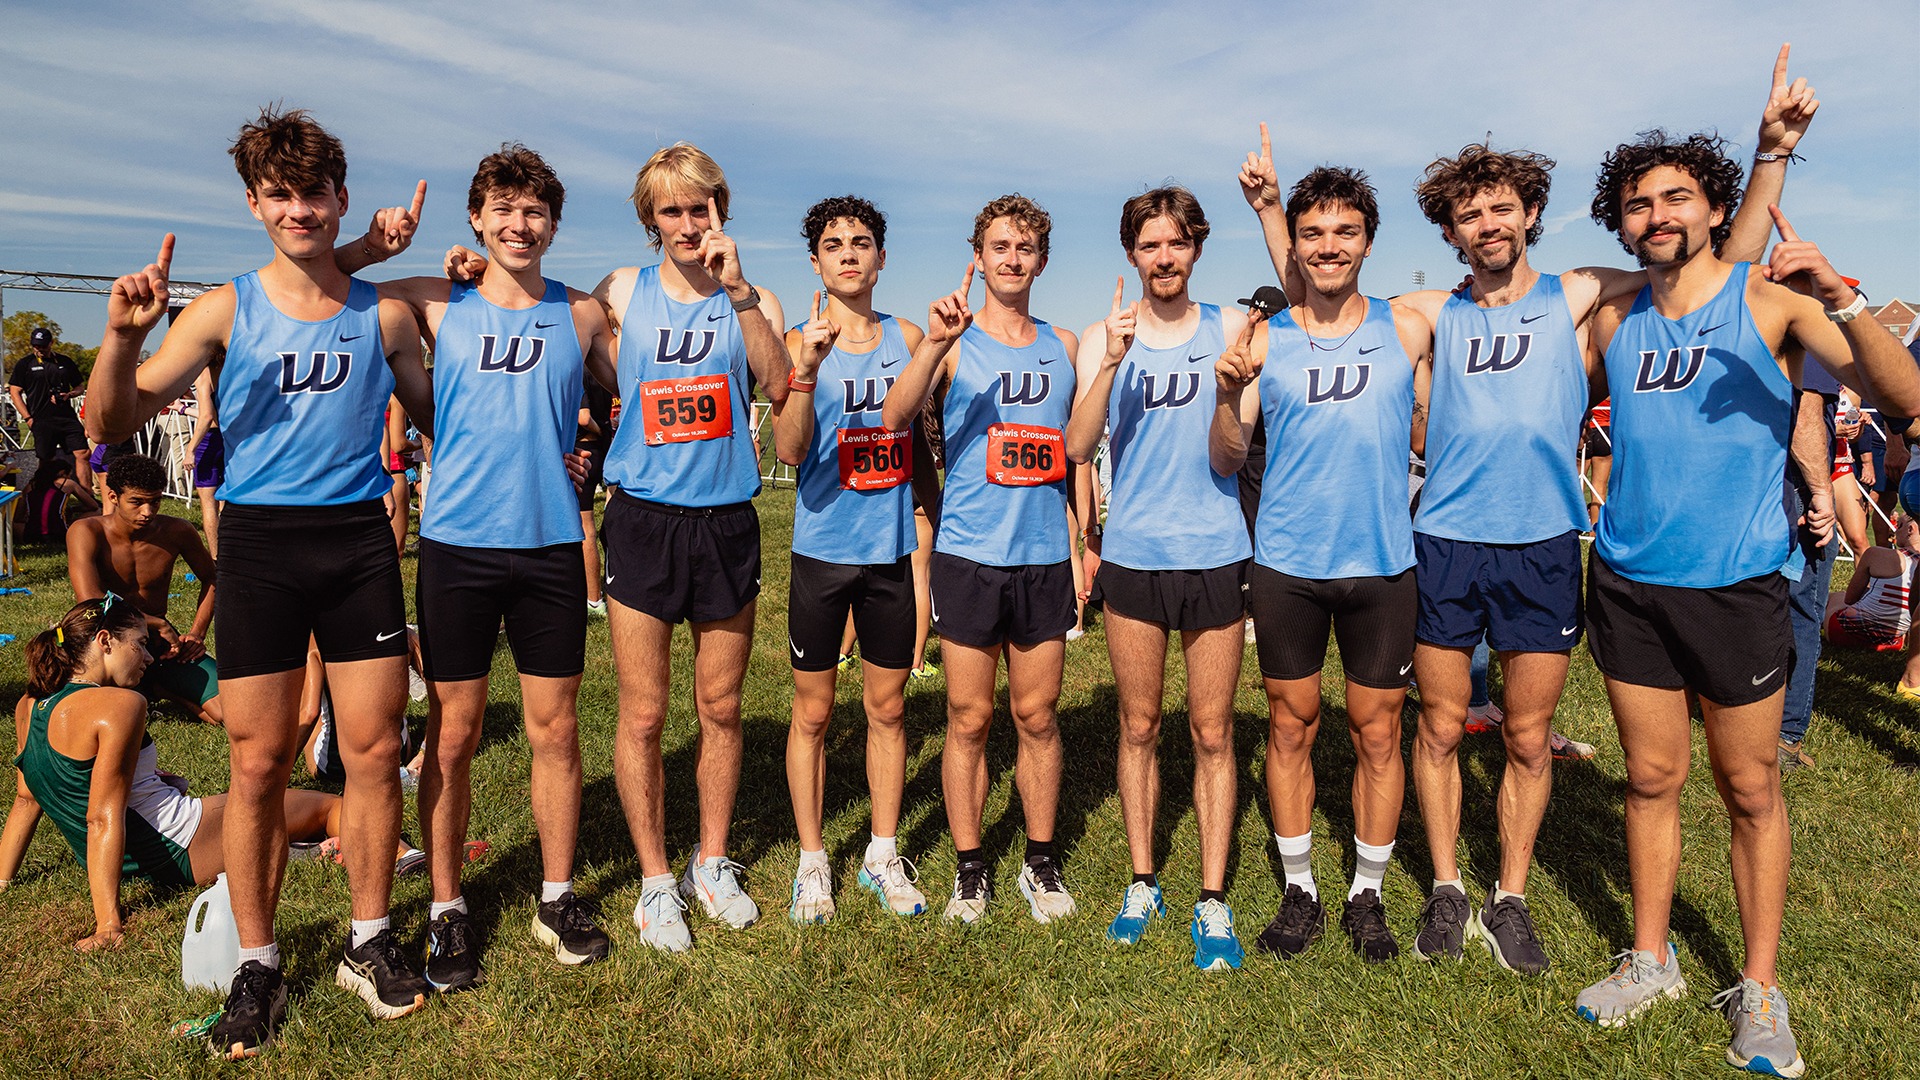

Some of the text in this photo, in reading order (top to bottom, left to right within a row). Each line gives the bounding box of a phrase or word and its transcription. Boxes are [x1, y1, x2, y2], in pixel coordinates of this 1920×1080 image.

[476, 333, 546, 374] W
[654, 327, 717, 367] W
[1465, 332, 1533, 376] W
[275, 351, 353, 394] W
[1302, 363, 1372, 405] W
[1634, 344, 1709, 394] W
[645, 381, 724, 396] Lewis Crossover
[996, 370, 1051, 407] W
[1139, 371, 1201, 411] W
[658, 395, 716, 427] 559
[842, 430, 909, 443] Lewis Crossover
[992, 428, 1060, 441] Lewis Crossover
[853, 443, 903, 474] 560
[1001, 441, 1053, 471] 566
